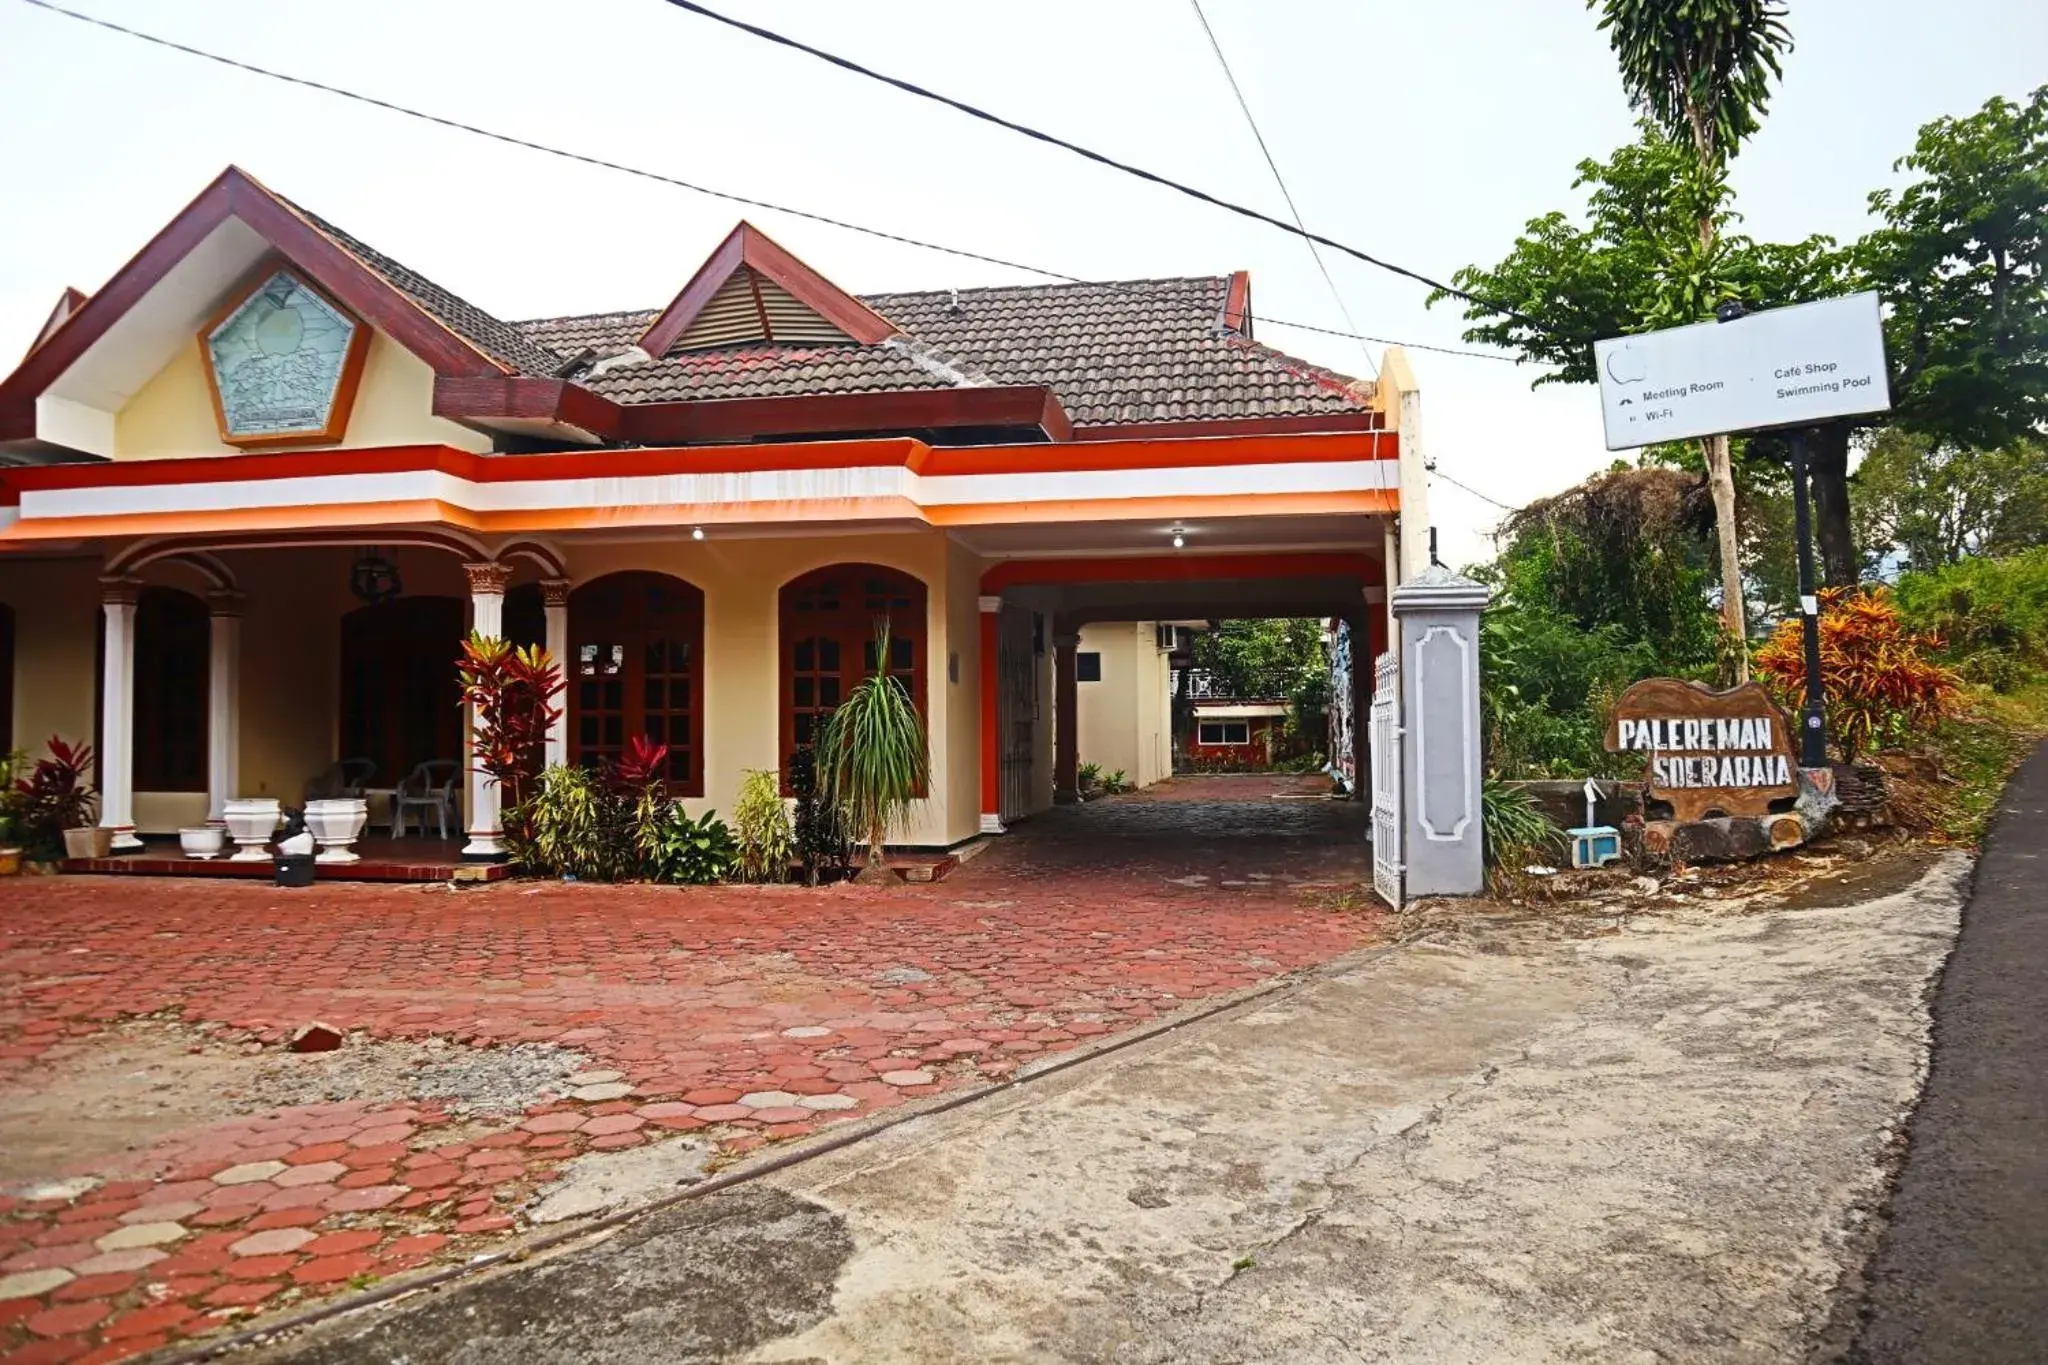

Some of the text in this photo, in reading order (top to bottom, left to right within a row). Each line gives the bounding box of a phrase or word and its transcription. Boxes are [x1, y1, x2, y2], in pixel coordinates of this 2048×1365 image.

[1804, 362, 1838, 374] Shop
[1643, 381, 1724, 402] Meeting Room
[1776, 375, 1872, 399] Swimming Pool
[1645, 408, 1673, 421] Wi-Fi
[1618, 717, 1773, 751] PALEREMAN
[1652, 755, 1793, 788] SOERABAIA
